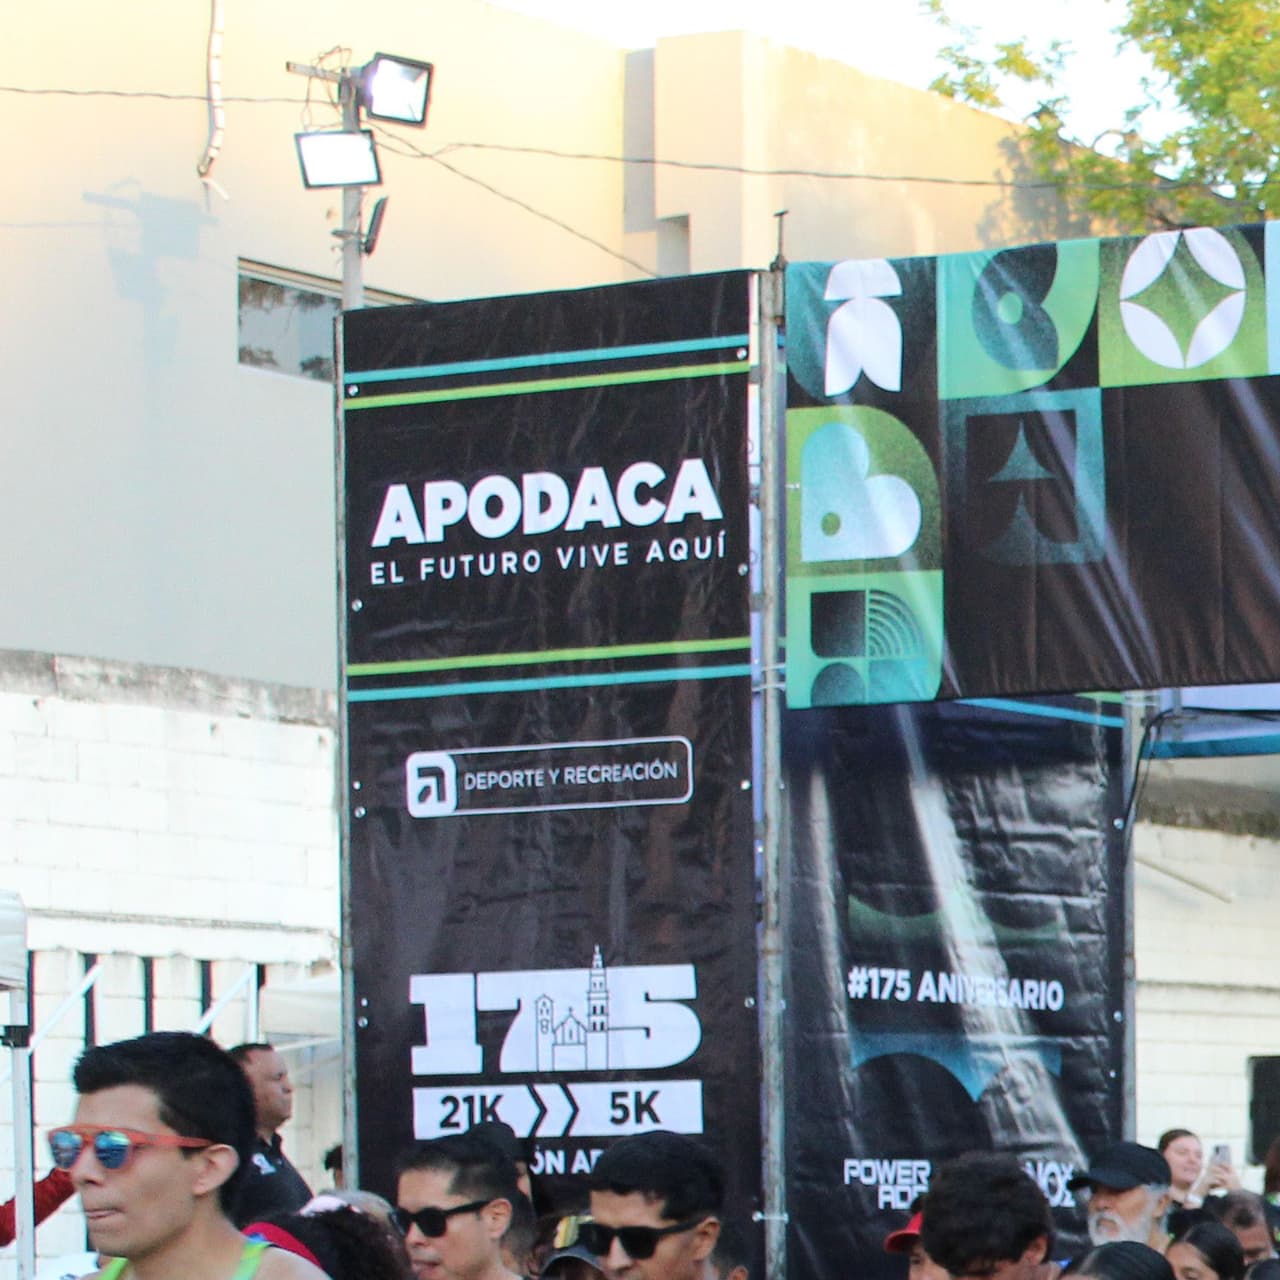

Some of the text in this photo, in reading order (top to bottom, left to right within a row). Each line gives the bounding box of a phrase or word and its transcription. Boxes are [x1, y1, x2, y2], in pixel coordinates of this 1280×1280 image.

[370, 458, 724, 548] APODACA
[370, 530, 727, 585] EL FUTURO VIVE AQUÍ
[464, 757, 678, 791] DEPORTE Y RECREACIÓN
[847, 967, 1065, 1012] #175 ANIVERSARIO
[409, 963, 702, 1076] 175
[438, 1090, 661, 1129] 21K 5K
[843, 1158, 931, 1185] POWER
